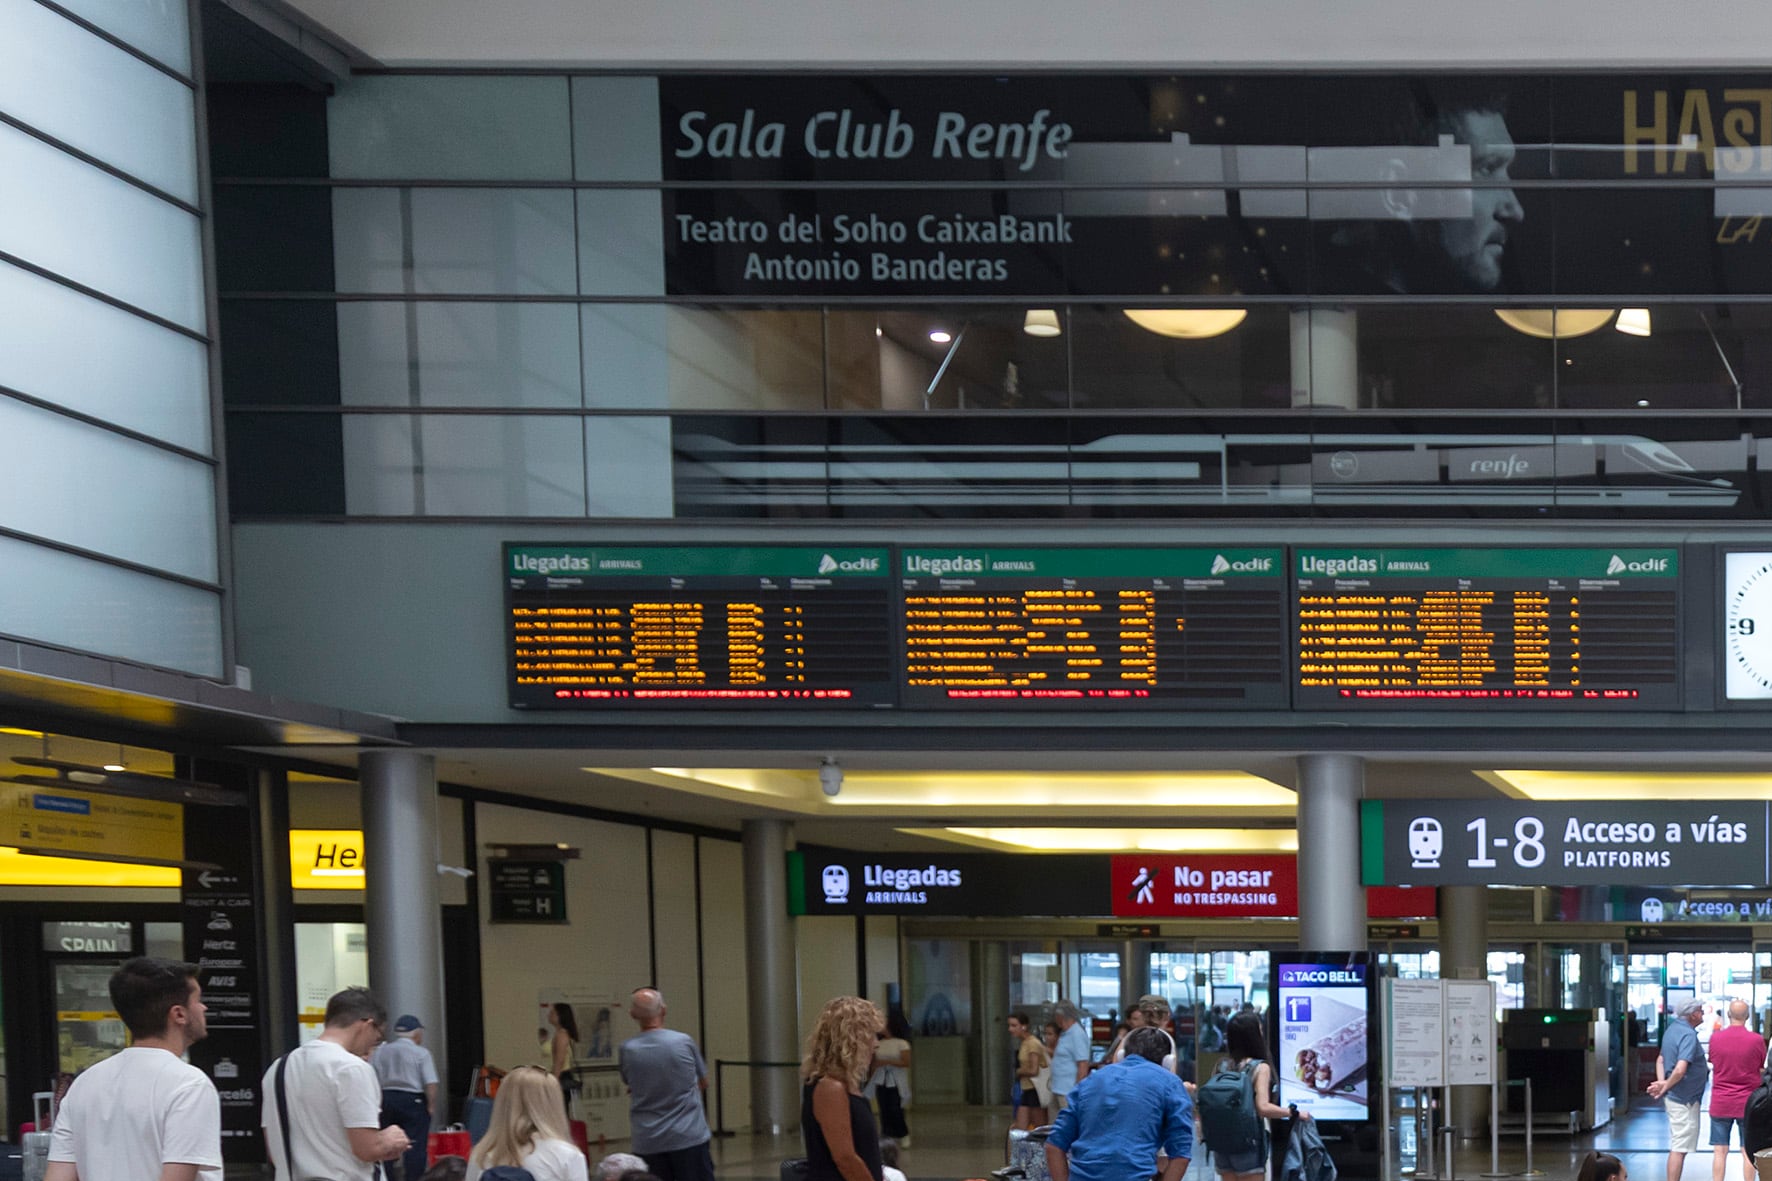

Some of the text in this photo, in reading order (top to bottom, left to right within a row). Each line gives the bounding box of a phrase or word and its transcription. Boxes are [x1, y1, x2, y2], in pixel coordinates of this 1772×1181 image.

[676, 108, 1073, 171] Sala Club Renfe
[676, 212, 1073, 243] Teatro del Soho CaixaBank
[1716, 211, 1762, 243] LA
[744, 251, 1007, 280] Antonio Banderas
[1470, 454, 1529, 478] renfe
[514, 554, 641, 573] Llegadas ARRIVALS
[839, 557, 879, 571] adif
[907, 555, 1035, 574] Llegadas ARRIVALS
[1231, 557, 1272, 571] adif
[1302, 555, 1429, 574] Llegadas ARRIVALS
[1627, 557, 1668, 572] adif
[1739, 618, 1754, 635] 9
[1466, 815, 1746, 868] 1-8 Acceso a vías
[315, 844, 364, 868] He
[1564, 851, 1670, 867] PLATFORMS
[864, 865, 961, 889] Llegadas
[1174, 867, 1272, 893] No pasar
[866, 891, 927, 904] ARRIVALS
[1175, 893, 1278, 904] NO TRESPASSING
[1678, 900, 1734, 915] Acceso
[1740, 902, 1749, 915] a
[60, 937, 117, 951] SPAIN
[202, 940, 236, 949] Hertz
[208, 976, 236, 987] AVIS
[1295, 971, 1361, 982] TACO BELL
[219, 1088, 254, 1100] rceló
